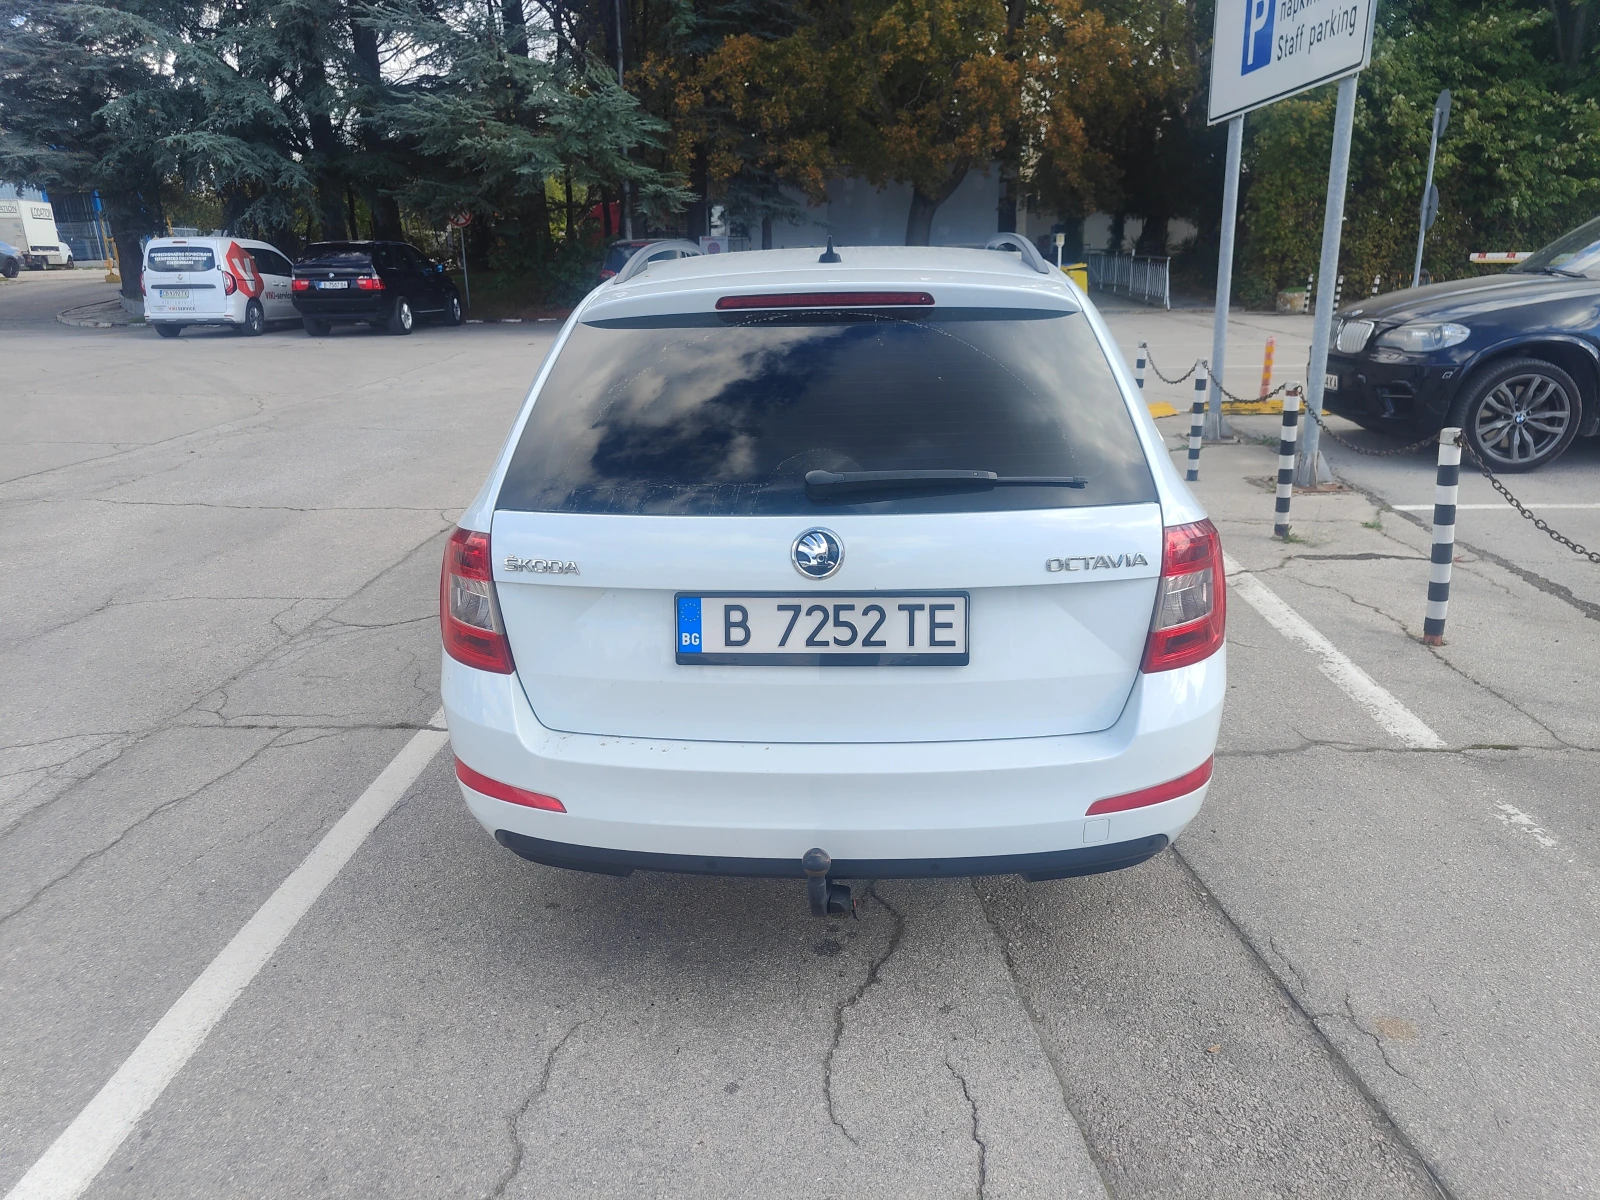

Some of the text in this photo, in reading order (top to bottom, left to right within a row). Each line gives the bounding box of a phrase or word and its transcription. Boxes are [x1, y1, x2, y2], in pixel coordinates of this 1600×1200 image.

[1277, 5, 1358, 61] Staff parking
[503, 554, 581, 575] ŠKODA
[1045, 552, 1149, 572] OCTAVIA
[724, 603, 957, 647] B 7252 TE
[681, 632, 701, 646] BG
